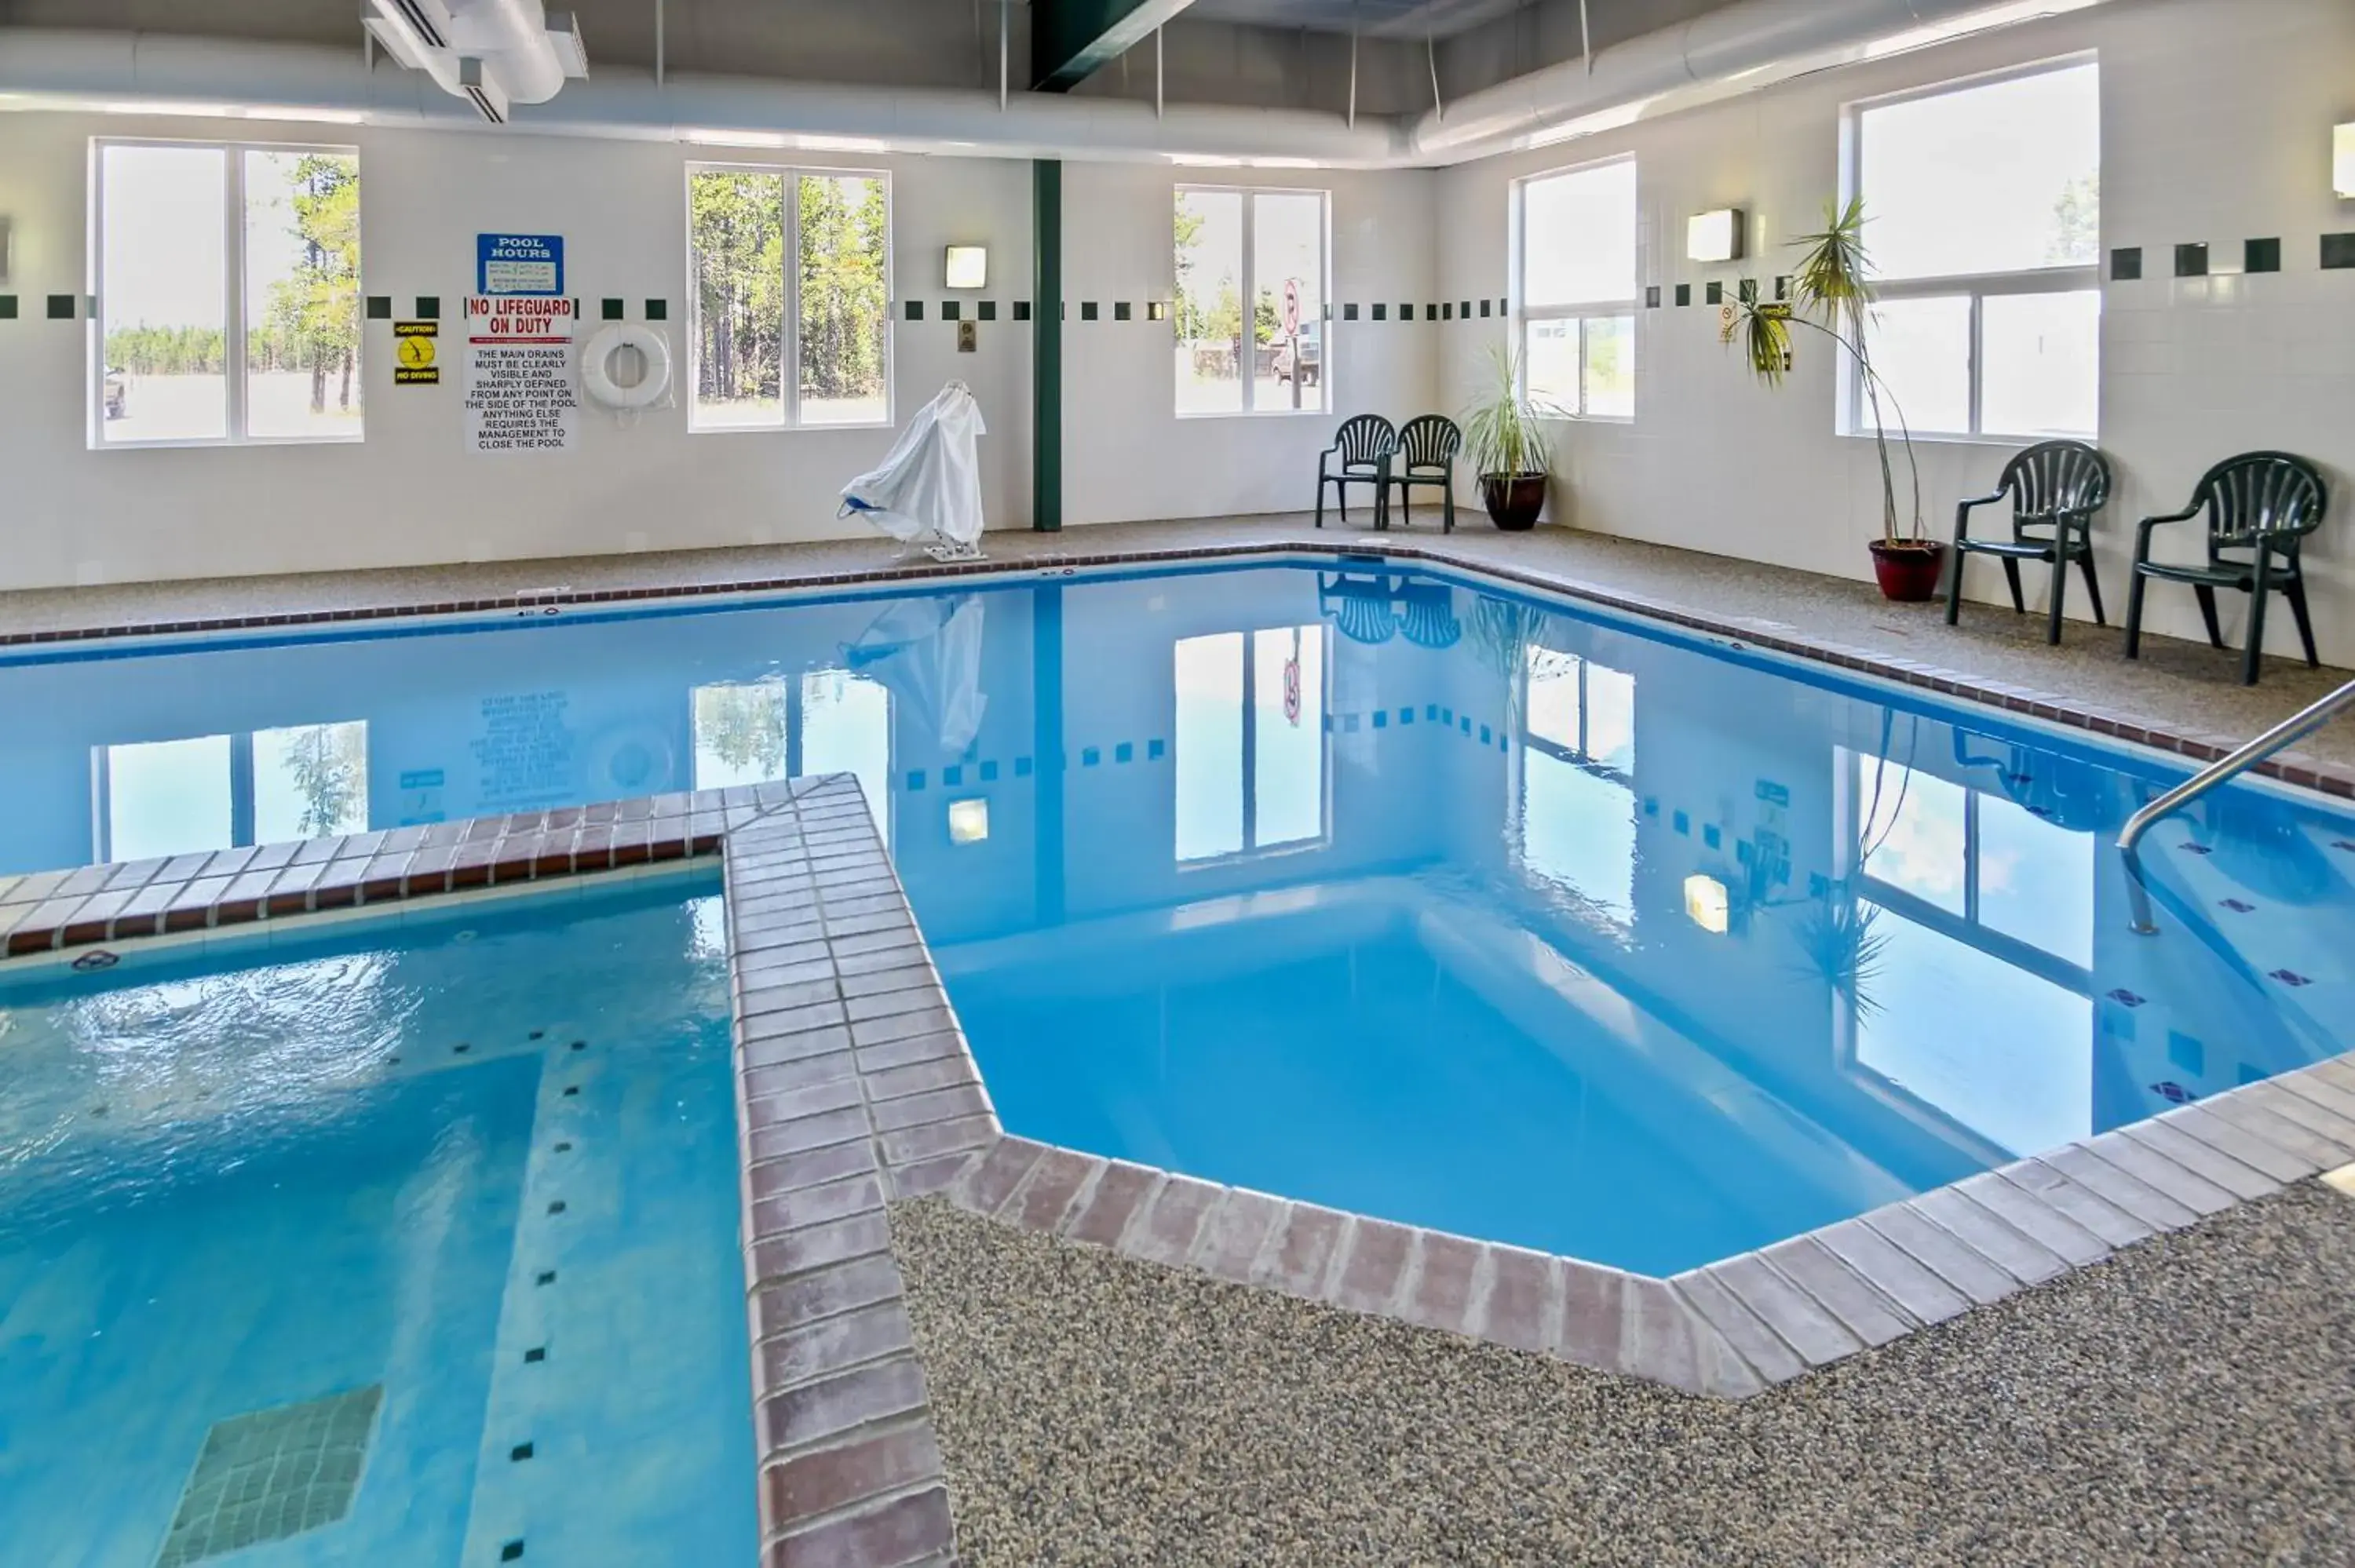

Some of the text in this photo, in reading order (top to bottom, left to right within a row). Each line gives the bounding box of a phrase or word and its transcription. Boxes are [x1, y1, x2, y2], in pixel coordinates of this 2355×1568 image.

[498, 238, 544, 247] POOL
[491, 249, 550, 258] HOURS
[471, 299, 571, 315] NO LIFEGUARD
[490, 317, 552, 333] ON DUTY
[475, 360, 502, 369] MUST
[476, 380, 522, 388] SHARPLY
[471, 390, 500, 399] FROM
[557, 389, 571, 398] ON
[465, 400, 484, 409] THE
[485, 419, 558, 428] REQUIRES THE
[478, 428, 565, 439] MANAGEMENT TO
[479, 439, 564, 450] CLOSE THE POOL
